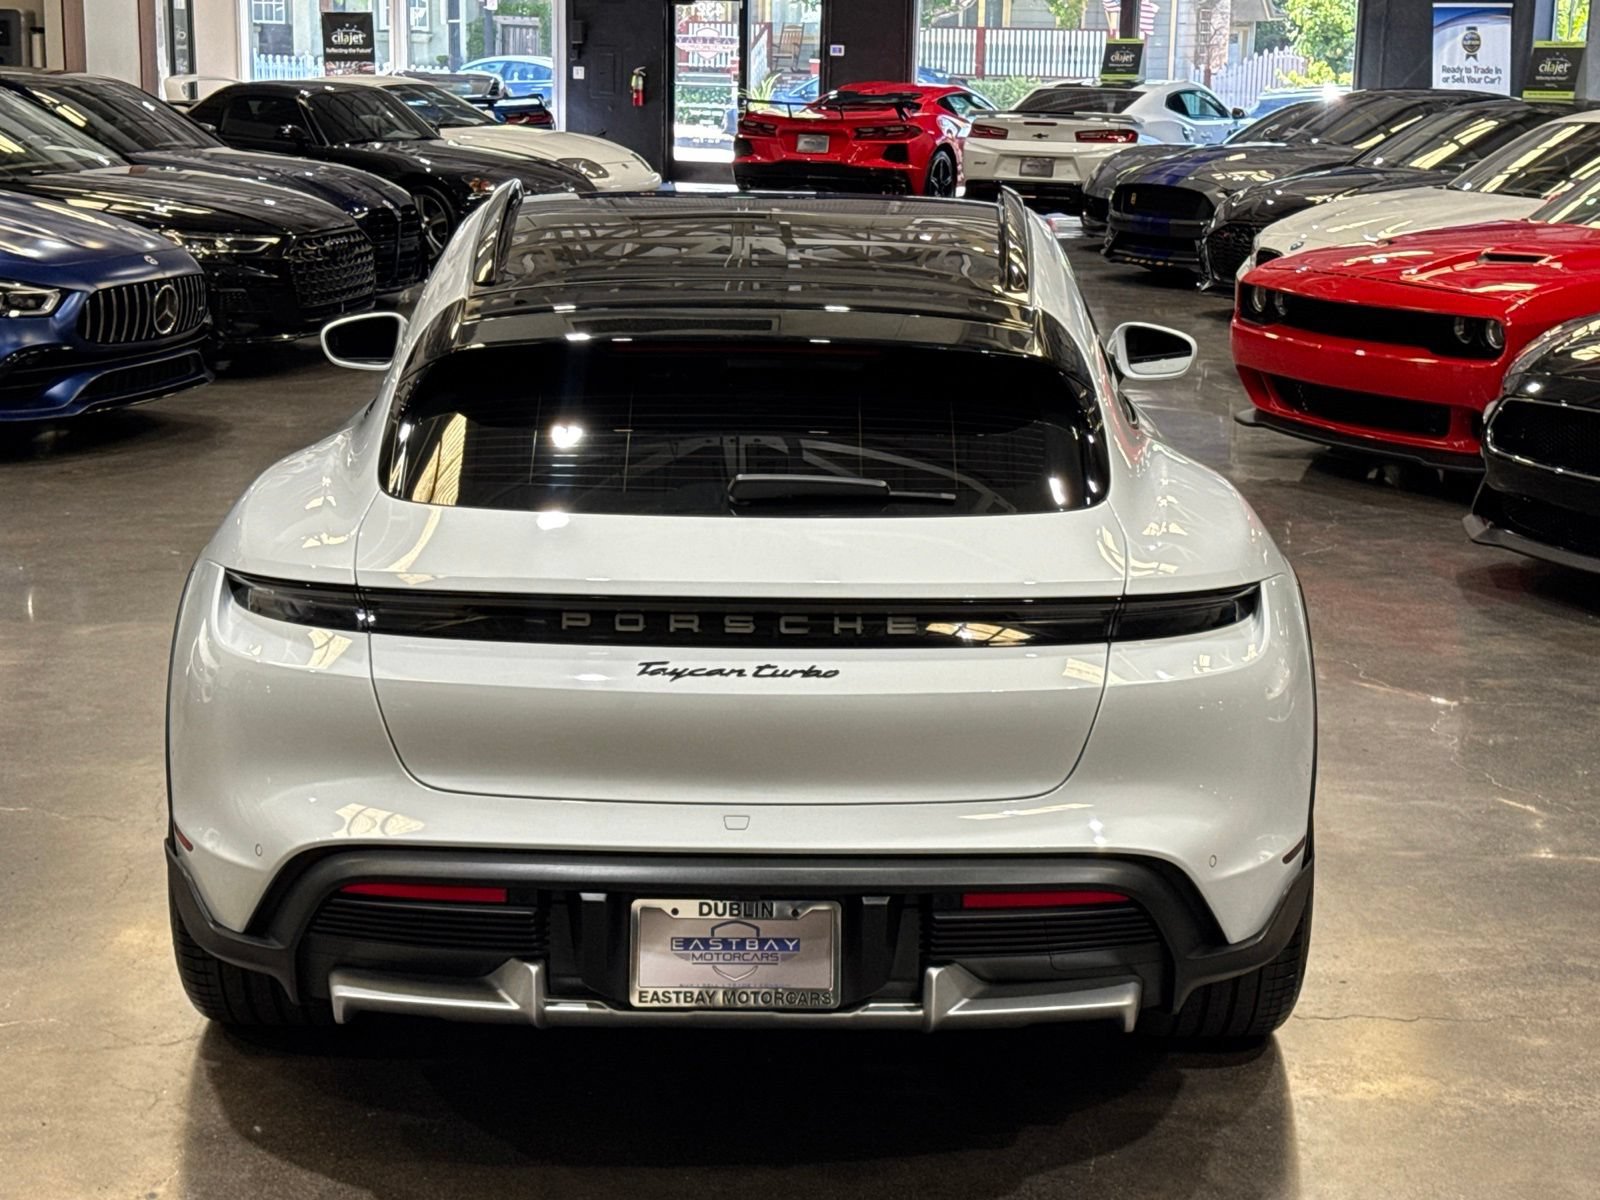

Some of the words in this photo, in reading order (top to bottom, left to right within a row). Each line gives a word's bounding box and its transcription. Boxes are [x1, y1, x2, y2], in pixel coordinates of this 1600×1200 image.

[331, 30, 365, 45] cilajet
[1442, 65, 1464, 75] Ready
[1464, 66, 1472, 74] to
[1473, 65, 1493, 74] Trade
[1494, 66, 1502, 74] In
[1538, 60, 1569, 75] cilajet
[1451, 75, 1465, 84] Sell
[1466, 75, 1482, 84] Your
[1483, 75, 1502, 84] Car?
[561, 612, 917, 635] PORSCHE
[637, 661, 748, 682] Taycan
[752, 663, 840, 678] turbo
[698, 901, 775, 918] DUBLIN
[671, 938, 800, 951] EASTBAY
[691, 952, 780, 962] MOTORCARS
[638, 990, 718, 1004] EASTBAY
[722, 990, 833, 1005] MOTORCARS
